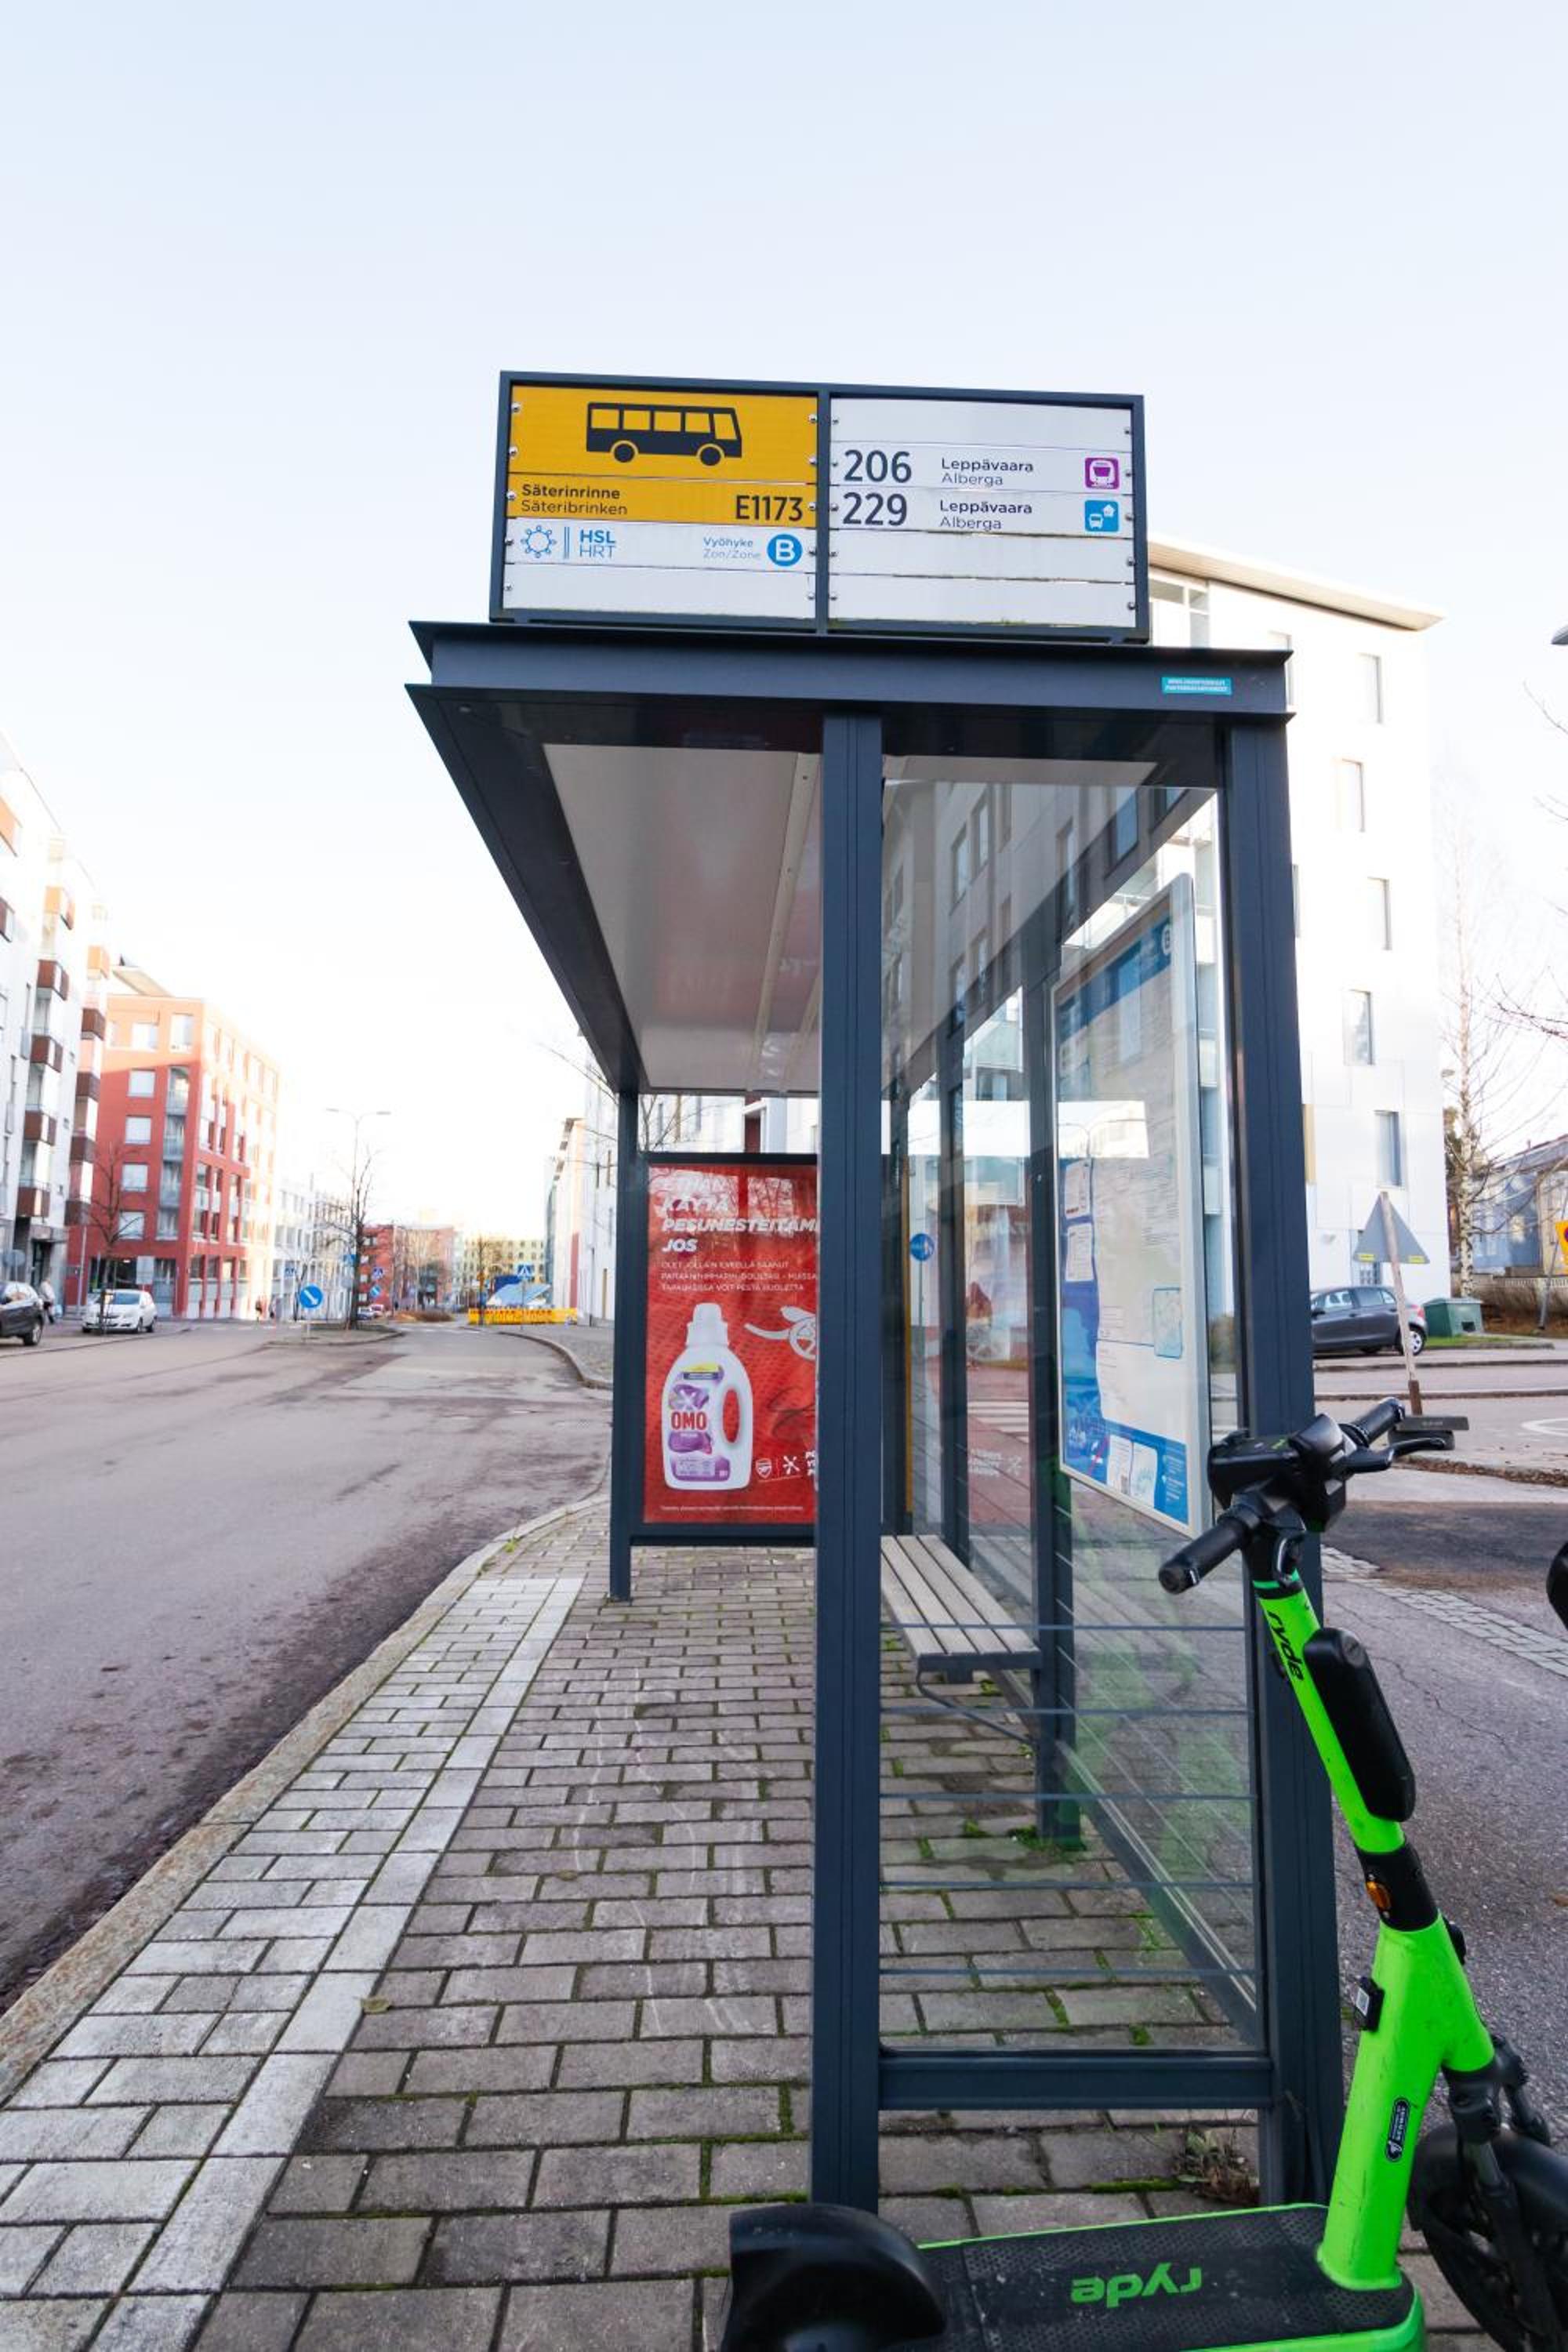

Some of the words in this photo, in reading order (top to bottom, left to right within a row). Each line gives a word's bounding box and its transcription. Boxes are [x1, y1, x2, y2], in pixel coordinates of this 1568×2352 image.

[844, 449, 912, 483] 206
[942, 457, 1033, 474] Leppävaara
[942, 472, 1003, 488] Alberga
[521, 484, 620, 500] Säterinrinne
[521, 499, 628, 515] Säteribrinken
[735, 495, 803, 521] E1173
[842, 492, 908, 526] 229
[940, 499, 1032, 516] Leppävaara
[940, 515, 1002, 531] Alberga
[579, 530, 616, 543] HSL
[703, 536, 753, 550] Vyöhyke
[579, 544, 616, 559] HRT
[703, 549, 761, 561] Zon/Zone
[775, 540, 795, 561] B
[662, 1238, 698, 1253] JOS
[671, 1412, 706, 1430] OMO
[1267, 1610, 1304, 1681] ryde
[1070, 2262, 1202, 2308] ryde
